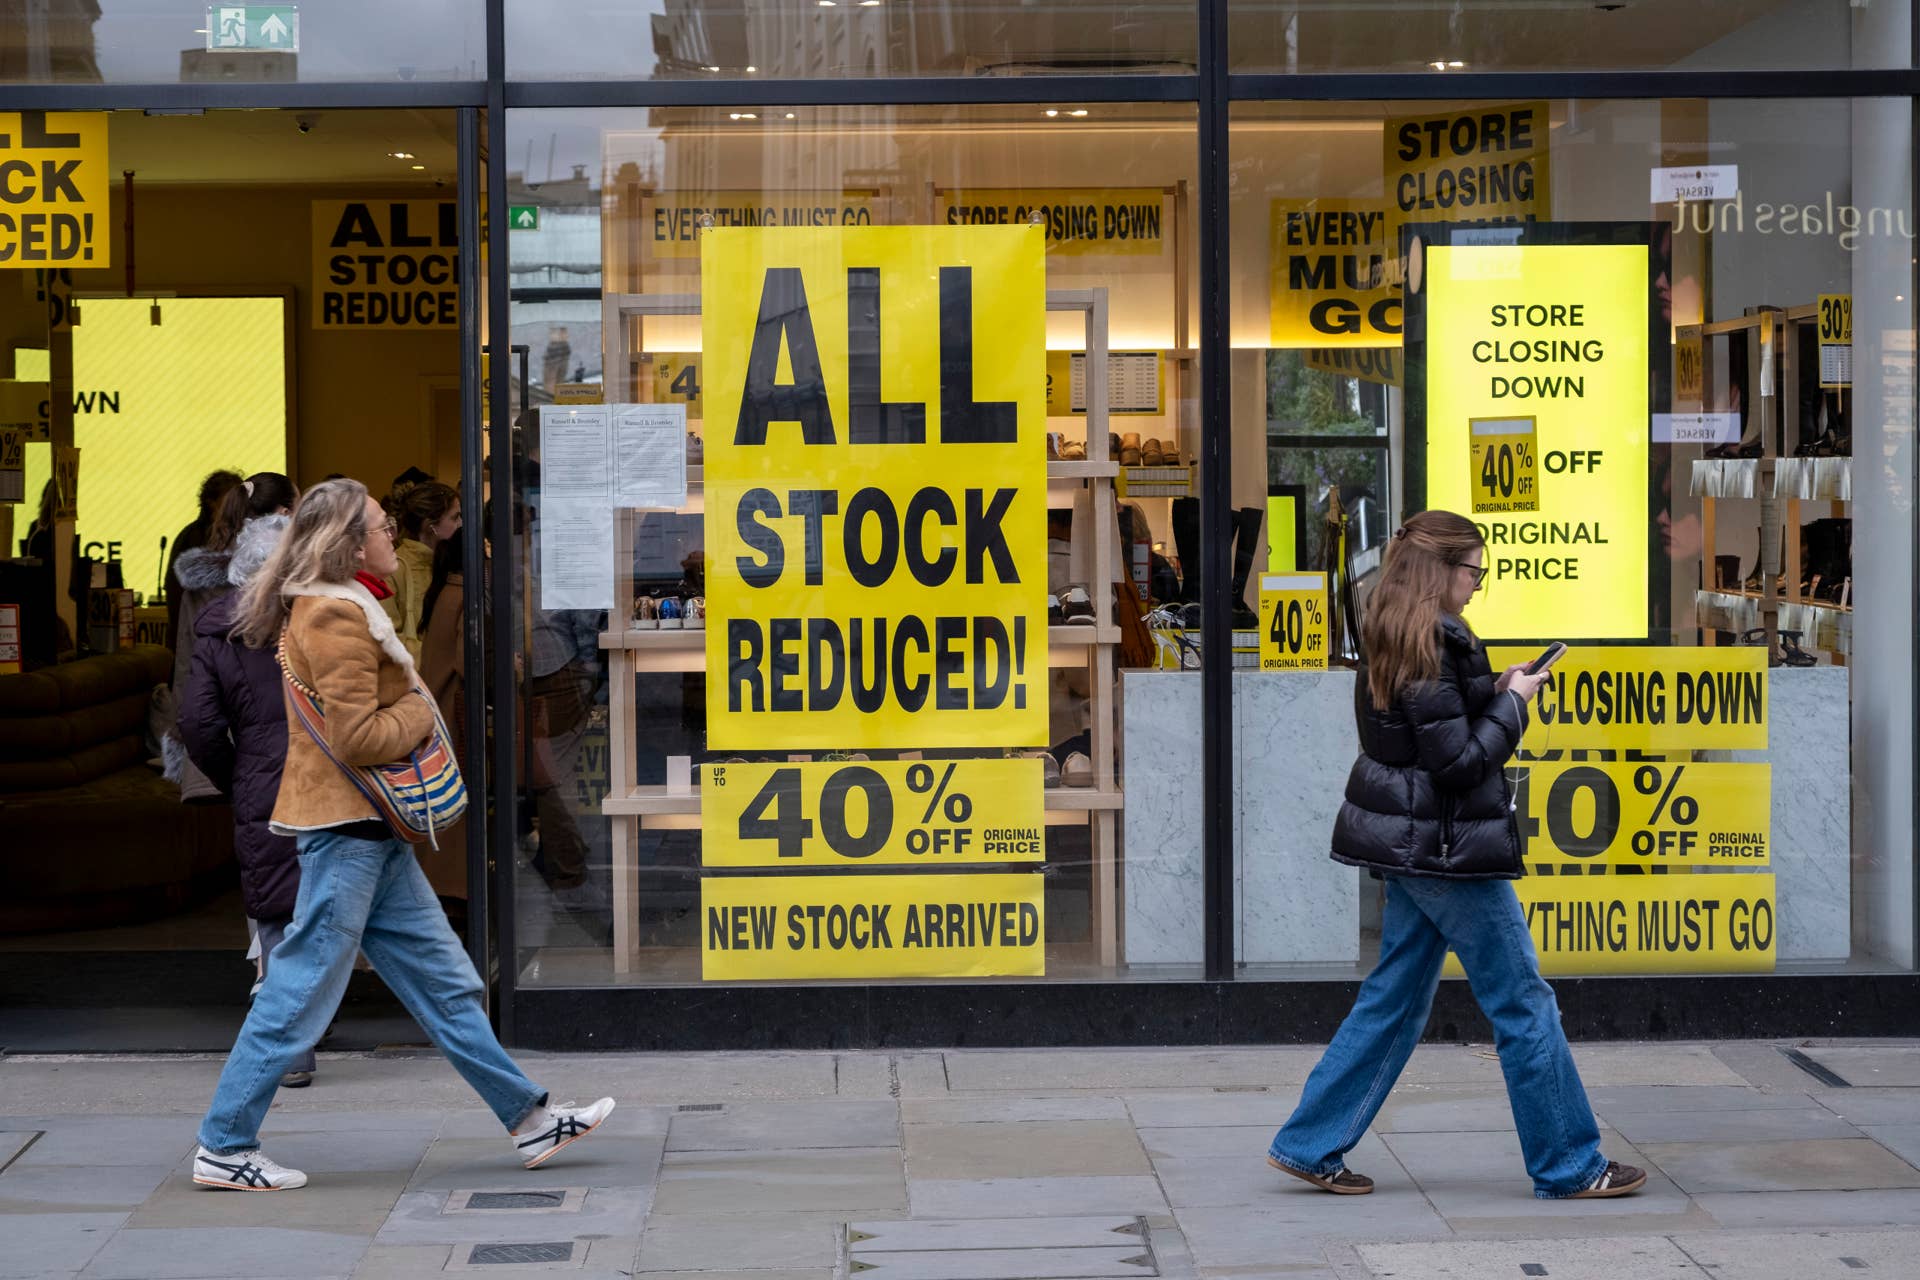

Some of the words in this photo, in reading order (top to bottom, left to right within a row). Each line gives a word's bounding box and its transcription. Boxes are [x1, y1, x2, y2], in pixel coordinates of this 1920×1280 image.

[1398, 110, 1533, 161] STORE
[1397, 161, 1534, 212] CLOSING
[1104, 204, 1160, 239] DOWN
[330, 255, 459, 285] STOC
[1491, 304, 1584, 327] STORE
[734, 266, 1018, 445] ALL
[1472, 340, 1604, 363] CLOSING
[1491, 376, 1585, 399] DOWN
[1482, 443, 1532, 498] 40%
[1544, 450, 1603, 474] OFF
[1518, 477, 1533, 494] OFF
[1475, 503, 1511, 512] ORIGINAL
[1513, 502, 1536, 511] PRICE
[735, 486, 1021, 588] STOCK
[1497, 557, 1579, 580] PRICE
[1271, 599, 1322, 654] 40%
[1307, 634, 1322, 651] OFF
[727, 614, 1027, 713] REDUCED!
[1264, 659, 1299, 668] ORIGINAL
[1301, 658, 1323, 668] PRICE
[1537, 671, 1665, 725] CLOSING
[1676, 671, 1762, 725] DOWN
[713, 767, 726, 777] UP
[713, 778, 726, 786] TO
[738, 763, 973, 858] 40%
[905, 828, 972, 855] OFF
[983, 828, 1041, 841] ORIGINAL
[1631, 830, 1698, 857] OFF
[1708, 832, 1766, 845] ORIGINAL
[984, 842, 1041, 854] PRICE
[1708, 845, 1766, 858] PRICE
[708, 905, 777, 950] NEW
[787, 904, 893, 951] STOCK
[902, 902, 1039, 949] ARRIVED
[1638, 899, 1720, 952] MUST
[1729, 898, 1773, 952] GO
